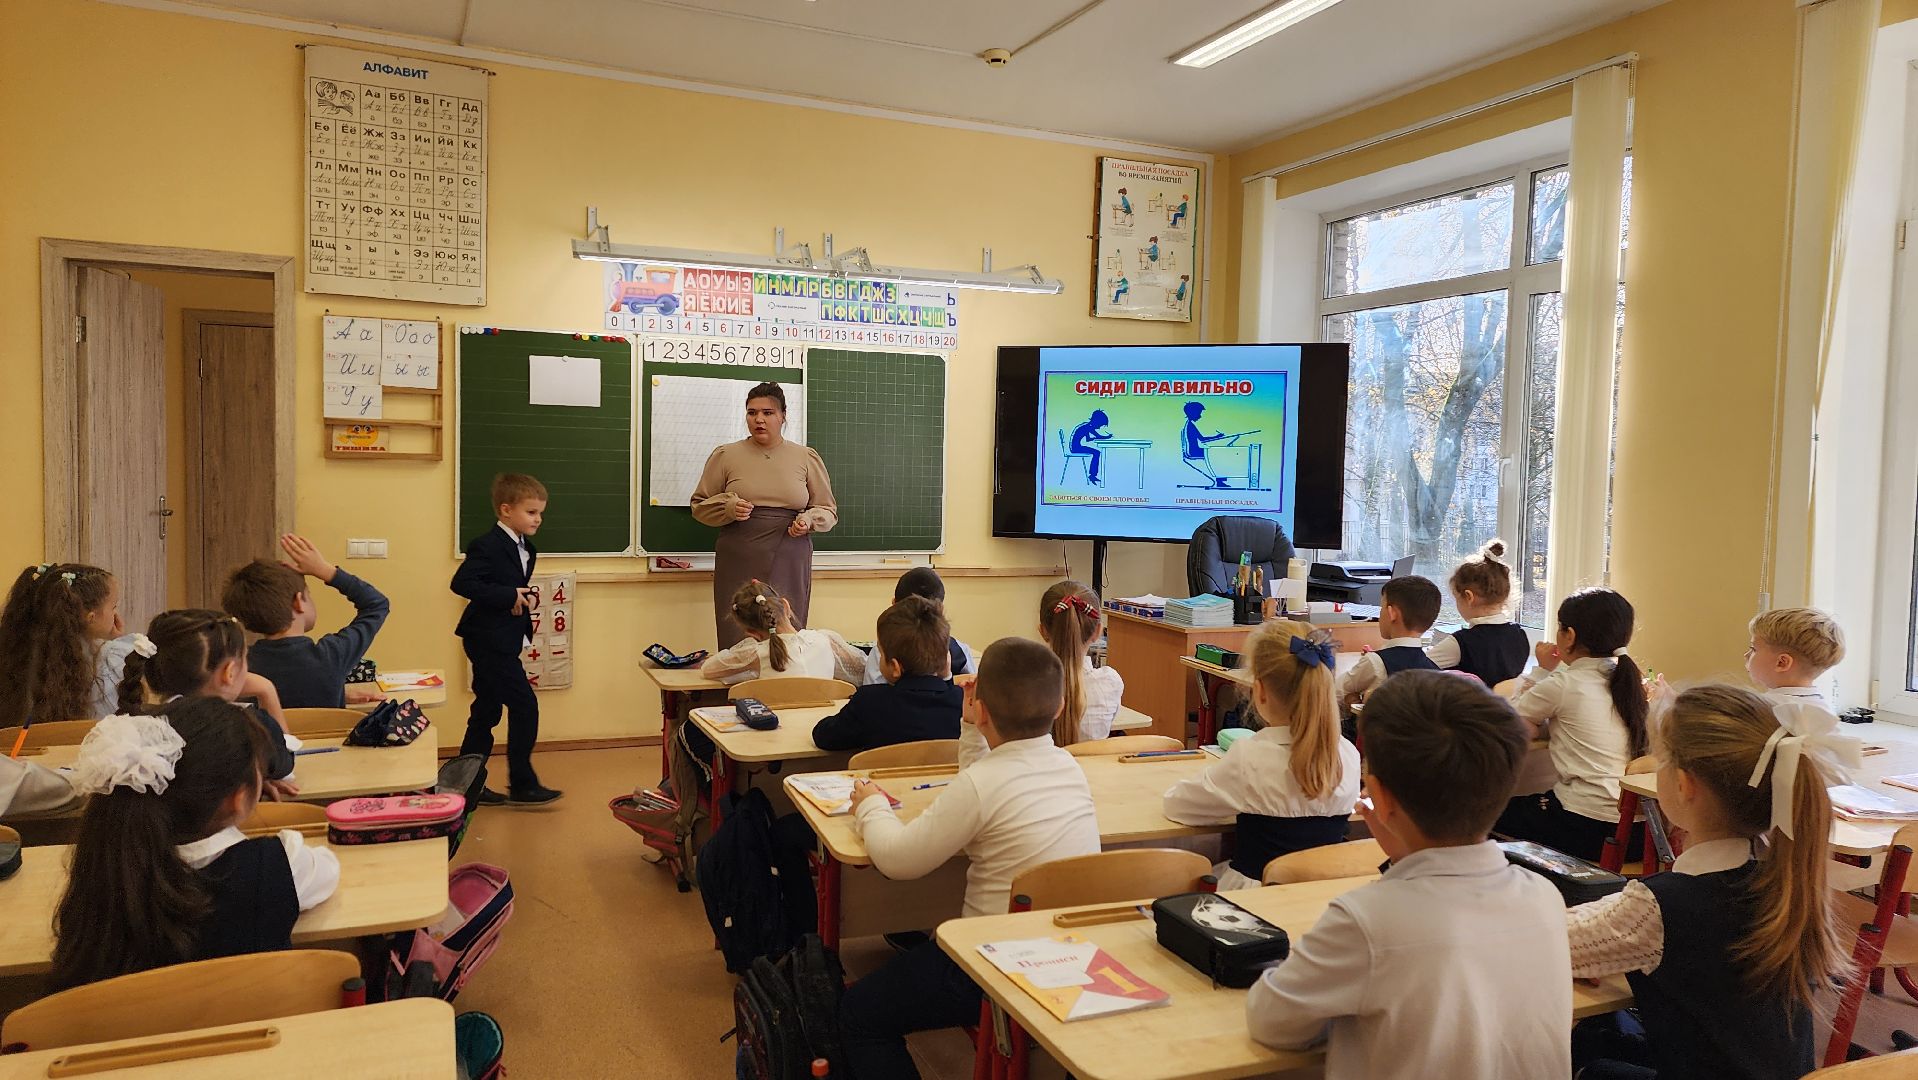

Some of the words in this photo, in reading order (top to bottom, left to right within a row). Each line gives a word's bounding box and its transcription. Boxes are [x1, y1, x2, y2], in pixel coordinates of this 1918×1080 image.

[363, 62, 429, 80] АЛФАВИТ
[365, 89, 381, 99] Аа
[389, 92, 405, 102] Бб
[414, 95, 430, 105] Вв
[439, 99, 452, 108] Гг
[461, 102, 479, 113] Дд
[314, 122, 330, 132] Ее
[341, 123, 357, 135] Ёё
[363, 128, 384, 139] Жж
[390, 131, 406, 141] Зз
[414, 135, 431, 144] Ии
[438, 136, 454, 147] Йй
[463, 140, 478, 150] Кк
[315, 162, 332, 171] Лл
[338, 164, 359, 174] Мм
[366, 167, 382, 177] Нн
[389, 170, 406, 179] Оо
[414, 172, 430, 182] Пп
[439, 175, 454, 186] Рр
[462, 177, 478, 187] Сс
[1111, 162, 1158, 174] ПРАВИЛЬНАЯ
[1158, 168, 1189, 177] ПОСАДКА
[1128, 172, 1150, 180] ВРЕМЯ
[1151, 174, 1182, 184] ЗАНЯТИЙ
[316, 200, 330, 209] Тт
[341, 203, 356, 213] Уу
[362, 205, 383, 216] Фф
[390, 208, 405, 217] Хх
[413, 210, 430, 221] Цц
[439, 212, 453, 222] Чч
[459, 215, 480, 225] Шш
[311, 239, 336, 250] Щщ
[413, 249, 429, 258] Ээ
[435, 251, 456, 260] Юю
[462, 253, 477, 262] Яя
[611, 316, 618, 327] 0
[630, 318, 636, 328] 1
[648, 318, 655, 329] 2
[666, 319, 674, 330] 3
[684, 321, 692, 331] 4
[702, 322, 710, 332] 5
[720, 323, 727, 333] 6
[737, 324, 744, 334] 7
[754, 325, 761, 335] 8
[771, 326, 778, 336] 9
[785, 327, 798, 338] 10
[803, 328, 815, 338] 11
[819, 329, 831, 340] 12
[834, 330, 848, 341] 13
[850, 331, 864, 342] 14
[866, 332, 879, 342] 15
[881, 333, 895, 343] 16
[898, 334, 910, 344] 17
[912, 335, 925, 345] 18
[928, 335, 940, 346] 19
[943, 336, 956, 346] 20
[786, 348, 803, 366] 1
[1075, 380, 1127, 397] СИДИ
[1132, 380, 1253, 395] ПРАВИЛЬНО
[1175, 497, 1223, 505] ПРАВИЛЬНАЯ
[552, 588, 567, 604] 4
[554, 616, 566, 632] 8
[1017, 954, 1079, 969] Прописи
[1094, 967, 1148, 995] 1
